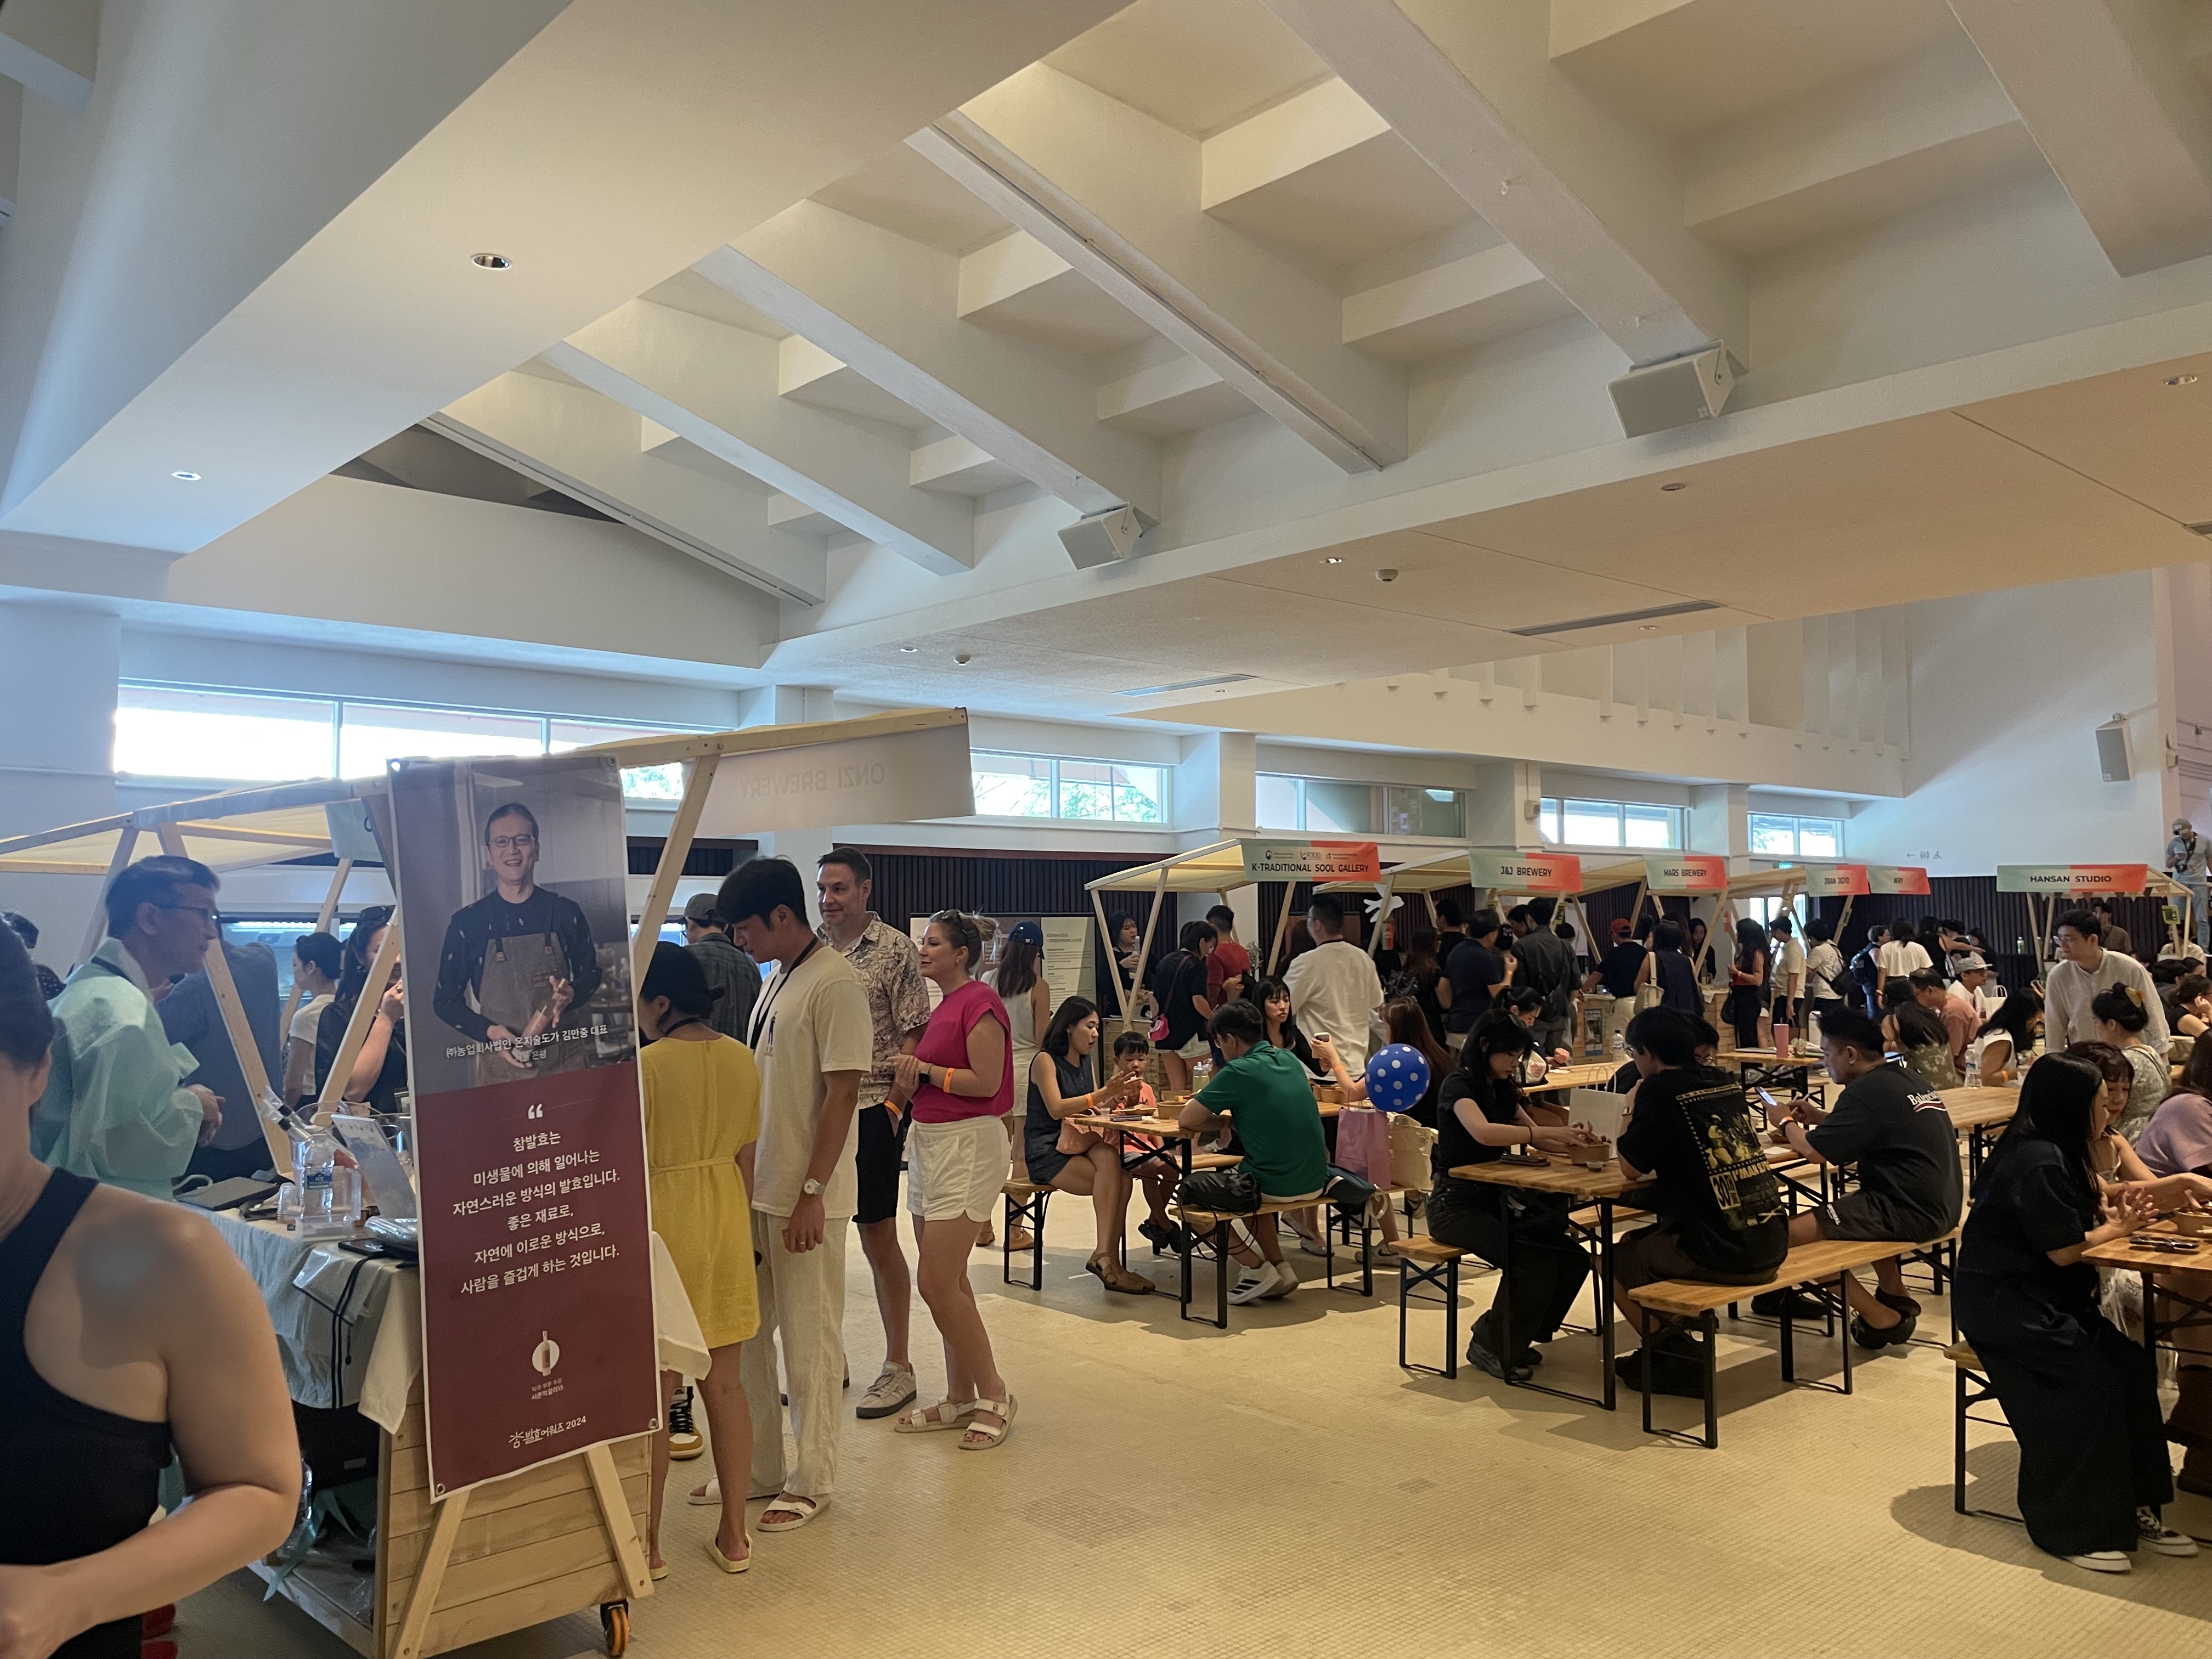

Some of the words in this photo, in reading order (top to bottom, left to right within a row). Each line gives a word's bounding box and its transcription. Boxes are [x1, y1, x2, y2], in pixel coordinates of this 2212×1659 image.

[1251, 863, 1311, 872] K-TRADITIONAL
[1339, 864, 1368, 872] GALLERY
[1500, 866, 1513, 875] J&J
[1517, 867, 1552, 877] BREWERY
[515, 1031, 560, 1048] 온지술도가
[562, 1028, 588, 1040] 김만중
[590, 1024, 608, 1035] 대표
[532, 1048, 546, 1060] 은평
[513, 1131, 561, 1152] 참발효는
[473, 1164, 523, 1186] 미생물에
[527, 1158, 550, 1175] 의해
[554, 1149, 600, 1170] 일어나는
[453, 1192, 517, 1216] 자연스러운
[521, 1182, 556, 1202] 방식의
[559, 1168, 620, 1193] 발효입니다.
[507, 1213, 532, 1231] 좋은
[535, 1204, 574, 1225] 재료로,
[475, 1243, 512, 1264] 자연에
[516, 1234, 552, 1254] 이로운
[555, 1223, 605, 1245] 방식으로,
[461, 1274, 499, 1294] 사람을
[503, 1263, 539, 1285] 즐겁게
[542, 1258, 566, 1273] 하는
[569, 1244, 619, 1268] 것입니다.
[566, 1415, 586, 1430] 2024
